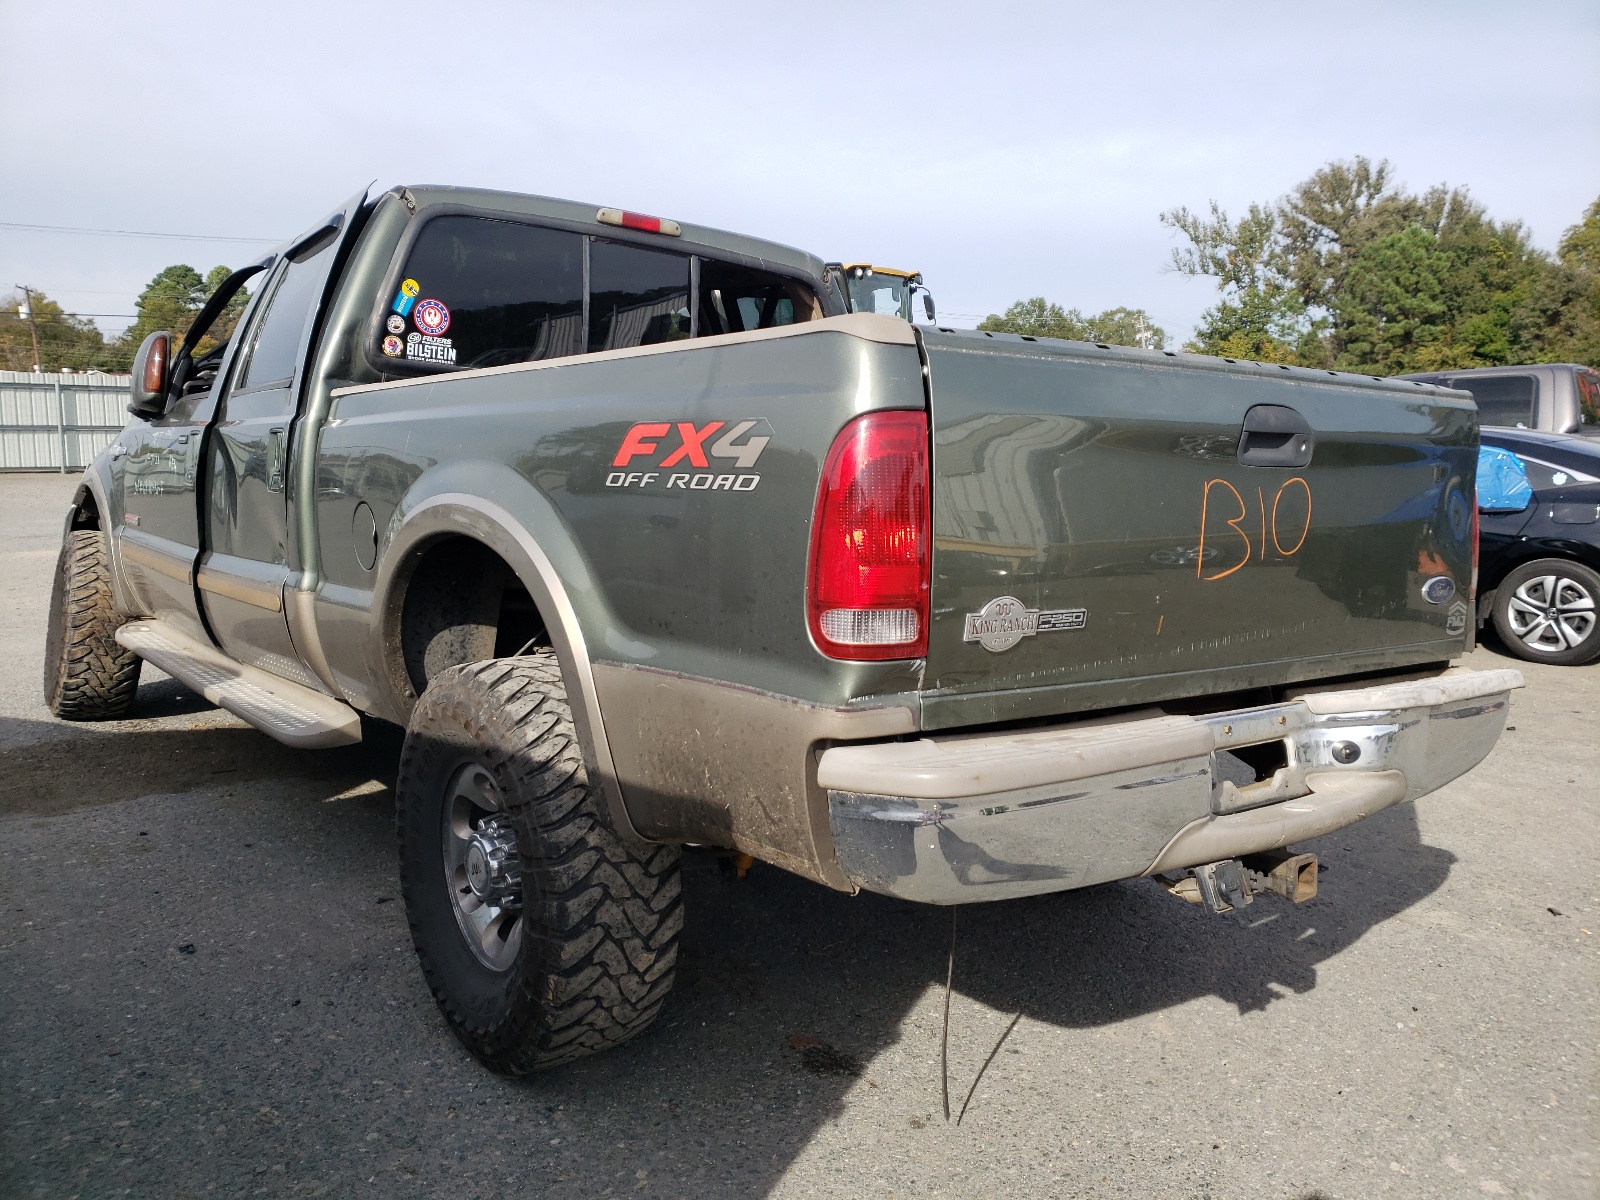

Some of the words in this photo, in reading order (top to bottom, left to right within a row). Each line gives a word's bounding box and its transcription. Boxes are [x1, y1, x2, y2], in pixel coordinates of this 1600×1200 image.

[422, 335, 452, 344] FILTERS
[407, 343, 456, 360] BILSTEIN
[612, 420, 771, 468] FX4
[605, 472, 659, 488] OFF
[666, 473, 761, 491] ROAD
[1197, 477, 1311, 580] B10
[971, 618, 998, 635] KING
[1000, 614, 1036, 634] RANCH
